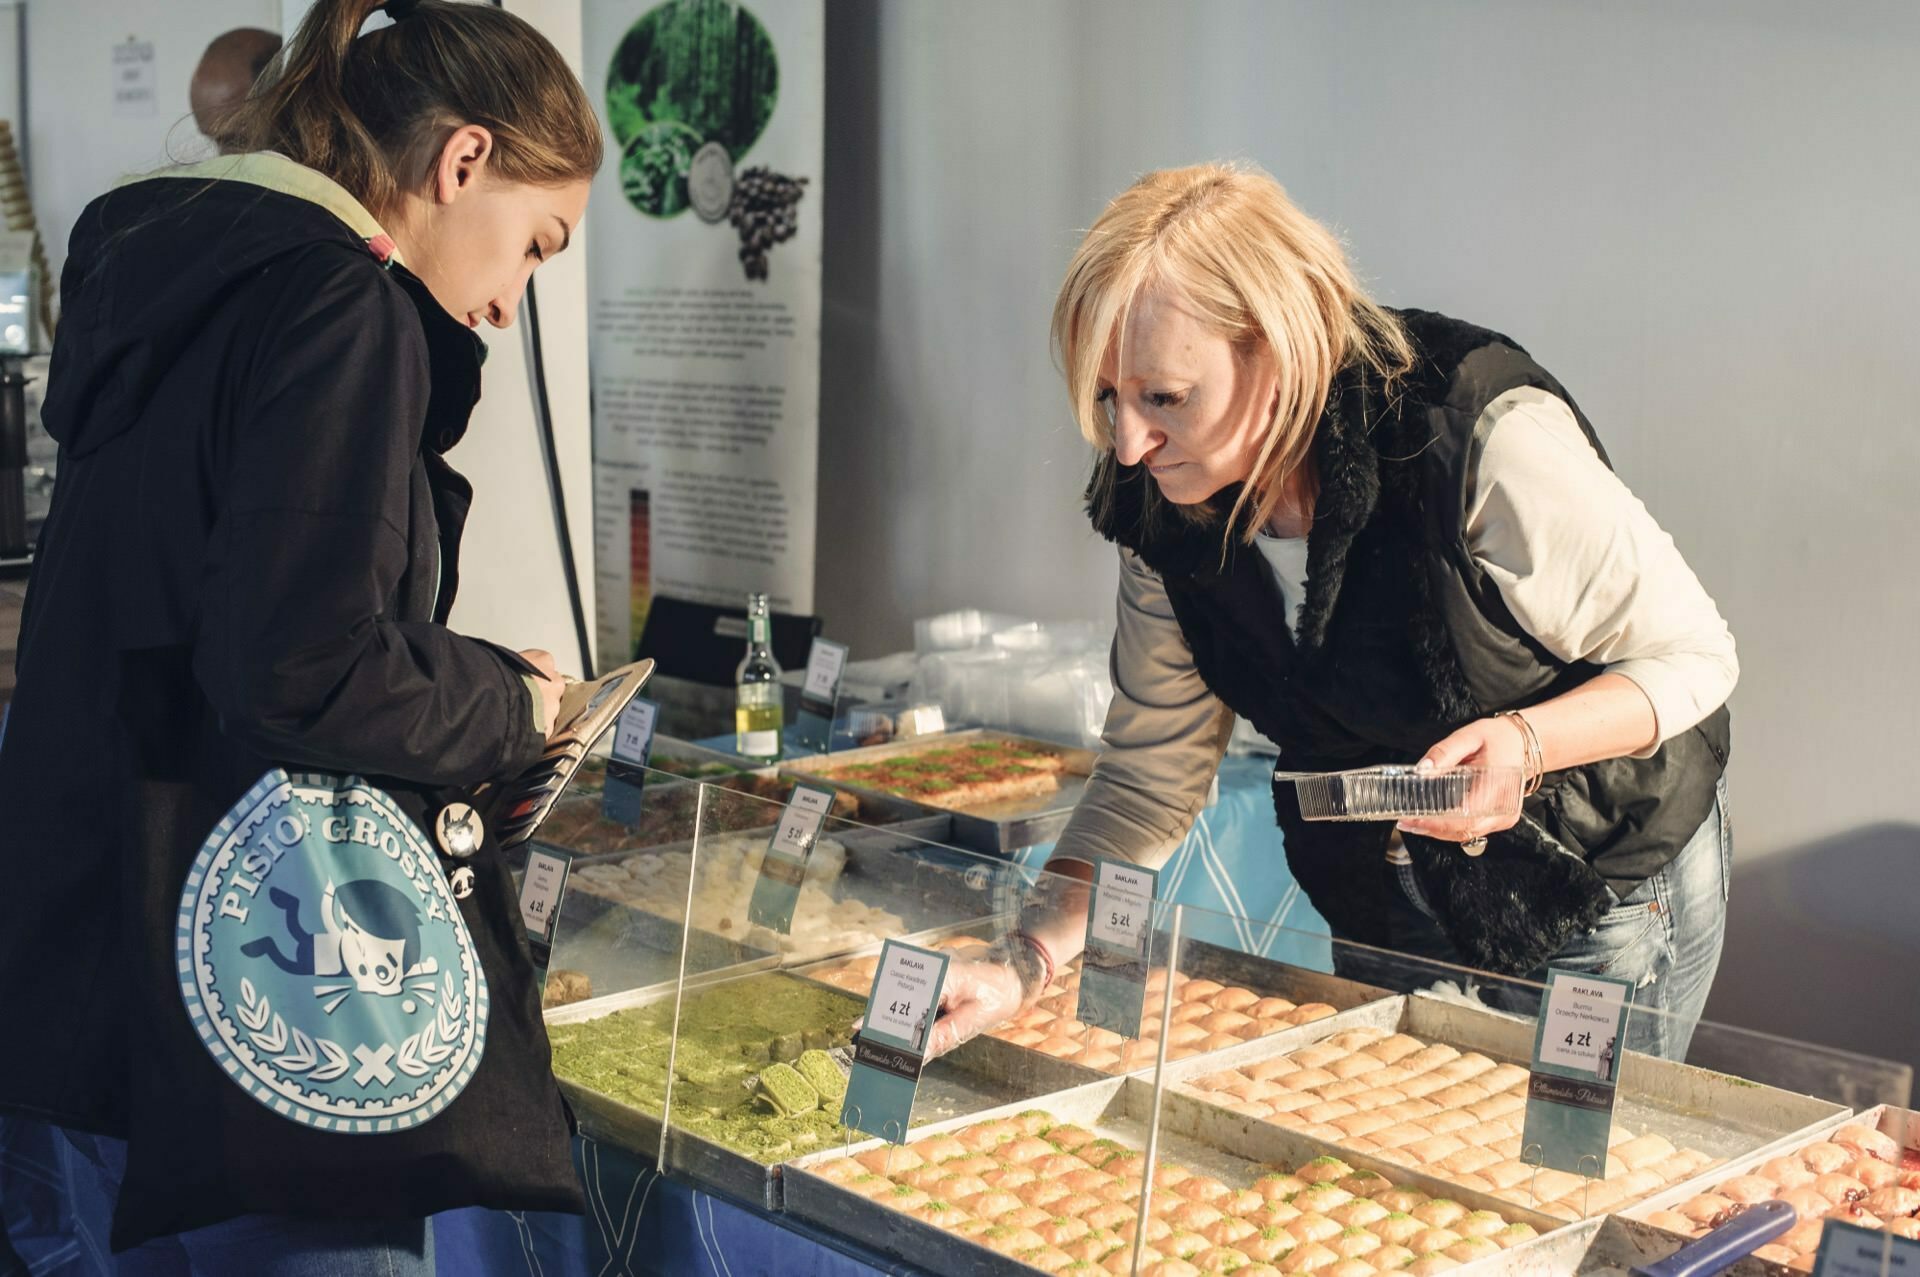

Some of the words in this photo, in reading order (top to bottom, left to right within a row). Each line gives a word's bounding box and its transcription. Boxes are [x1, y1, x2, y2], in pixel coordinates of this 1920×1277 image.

[788, 827, 794, 839] 5
[322, 816, 446, 922] GROSZY
[1114, 874, 1138, 885] BAKLAVA
[530, 900, 536, 912] 4
[536, 900, 544, 913] zł
[1111, 912, 1118, 925] 5
[1120, 913, 1130, 927] zł
[900, 958, 924, 970] BAKLAVA
[890, 1000, 898, 1014] 4
[899, 1001, 911, 1016] zł
[1555, 1009, 1578, 1020] Orzechy
[1564, 1032, 1573, 1046] 4
[1577, 1032, 1592, 1047] zł
